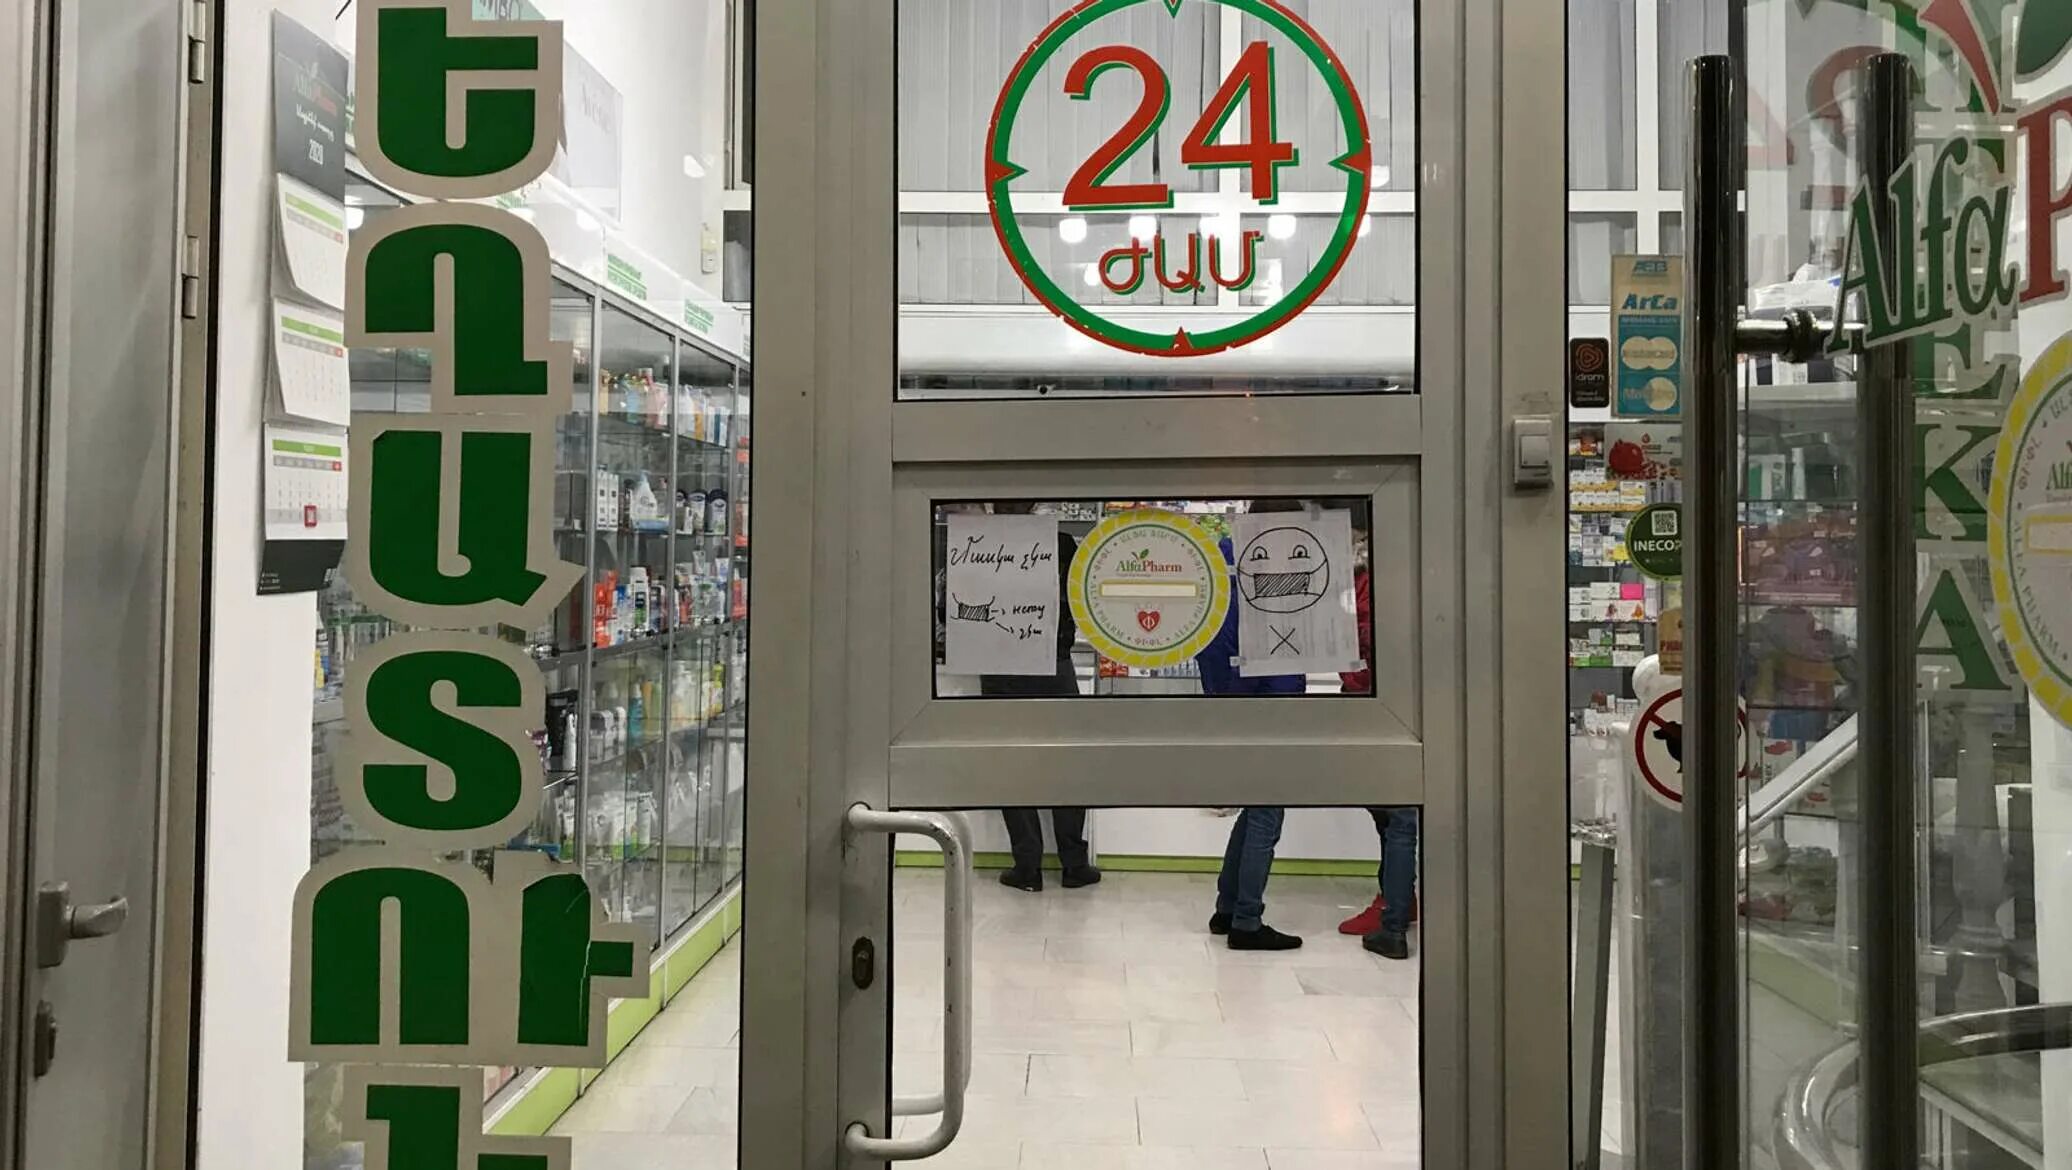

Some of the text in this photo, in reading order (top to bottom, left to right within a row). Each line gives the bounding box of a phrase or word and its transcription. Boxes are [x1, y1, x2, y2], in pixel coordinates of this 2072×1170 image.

[1063, 40, 1299, 211] 24
[1622, 293, 1678, 310] ArCa
[1116, 560, 1182, 572] AlfaPharm
